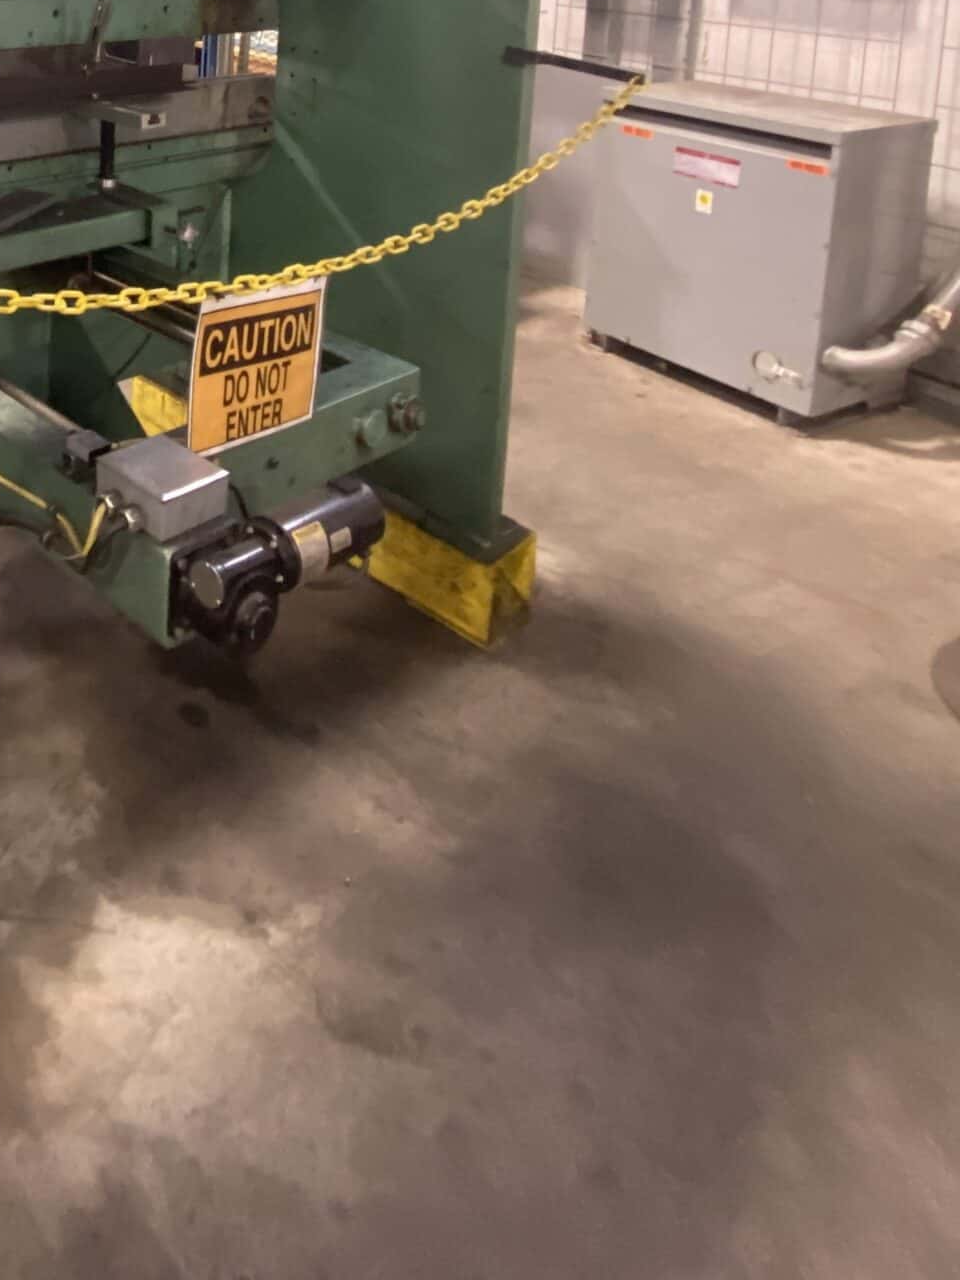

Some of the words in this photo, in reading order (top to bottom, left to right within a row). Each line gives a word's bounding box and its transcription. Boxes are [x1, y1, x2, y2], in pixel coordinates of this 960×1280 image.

[205, 311, 313, 369] CAUTION
[223, 370, 250, 408] DO
[254, 360, 292, 400] NOT
[226, 398, 283, 442] ENTER
